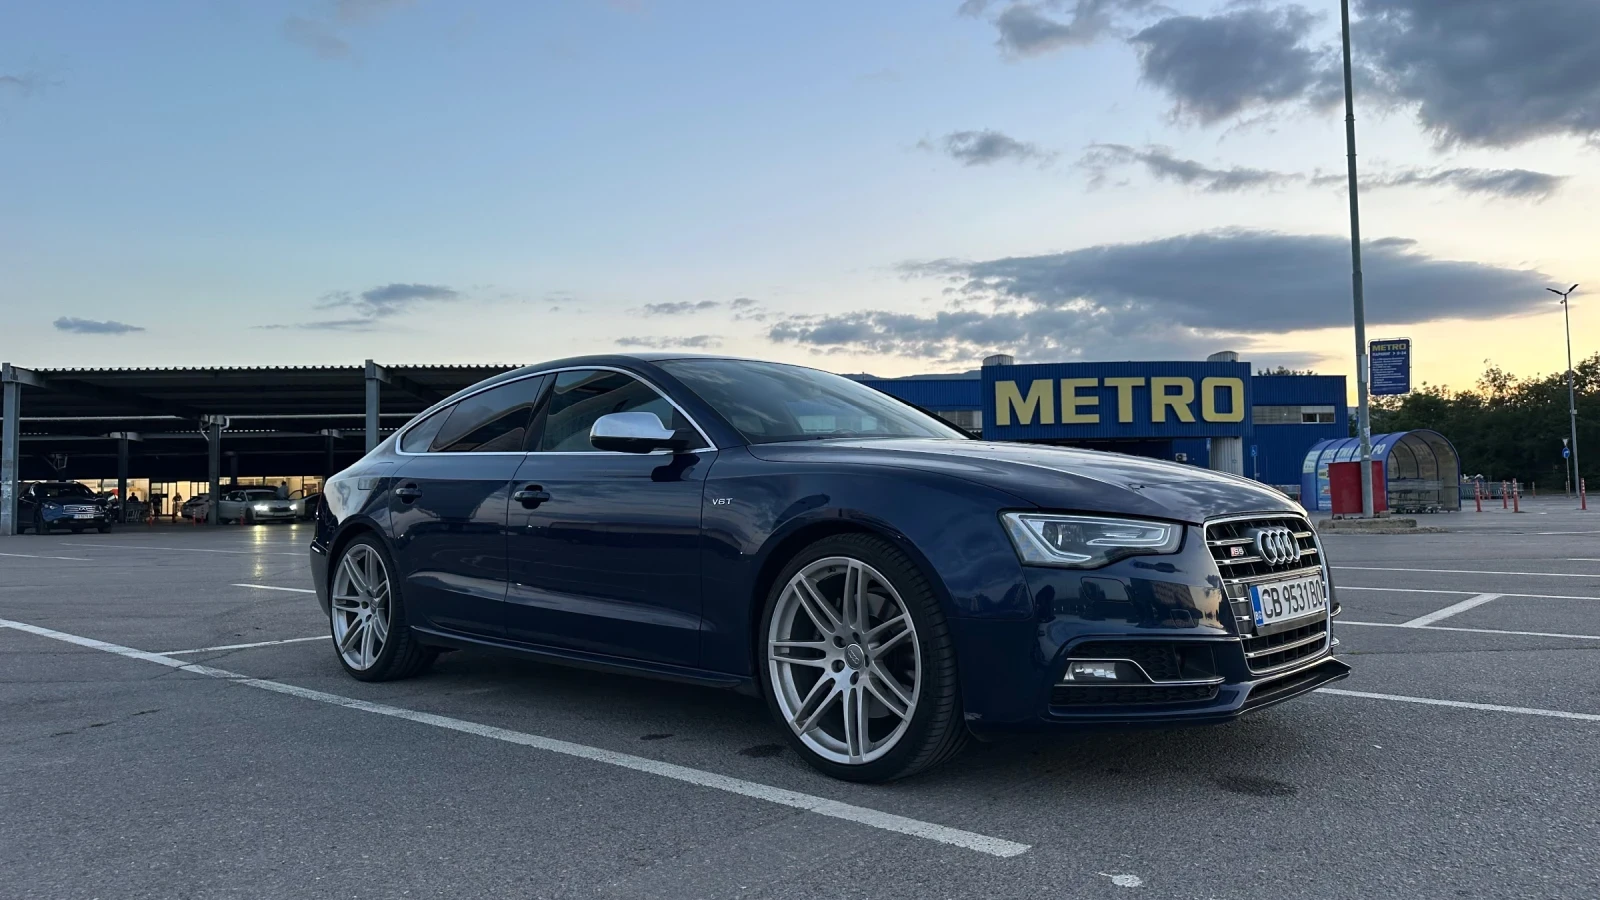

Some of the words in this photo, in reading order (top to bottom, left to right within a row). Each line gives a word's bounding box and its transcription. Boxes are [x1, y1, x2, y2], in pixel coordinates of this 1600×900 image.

[1372, 343, 1406, 351] METRO
[995, 376, 1245, 426] METRO
[712, 497, 733, 505] V6T
[1262, 587, 1283, 618] CB
[1283, 582, 1310, 615] 9531
